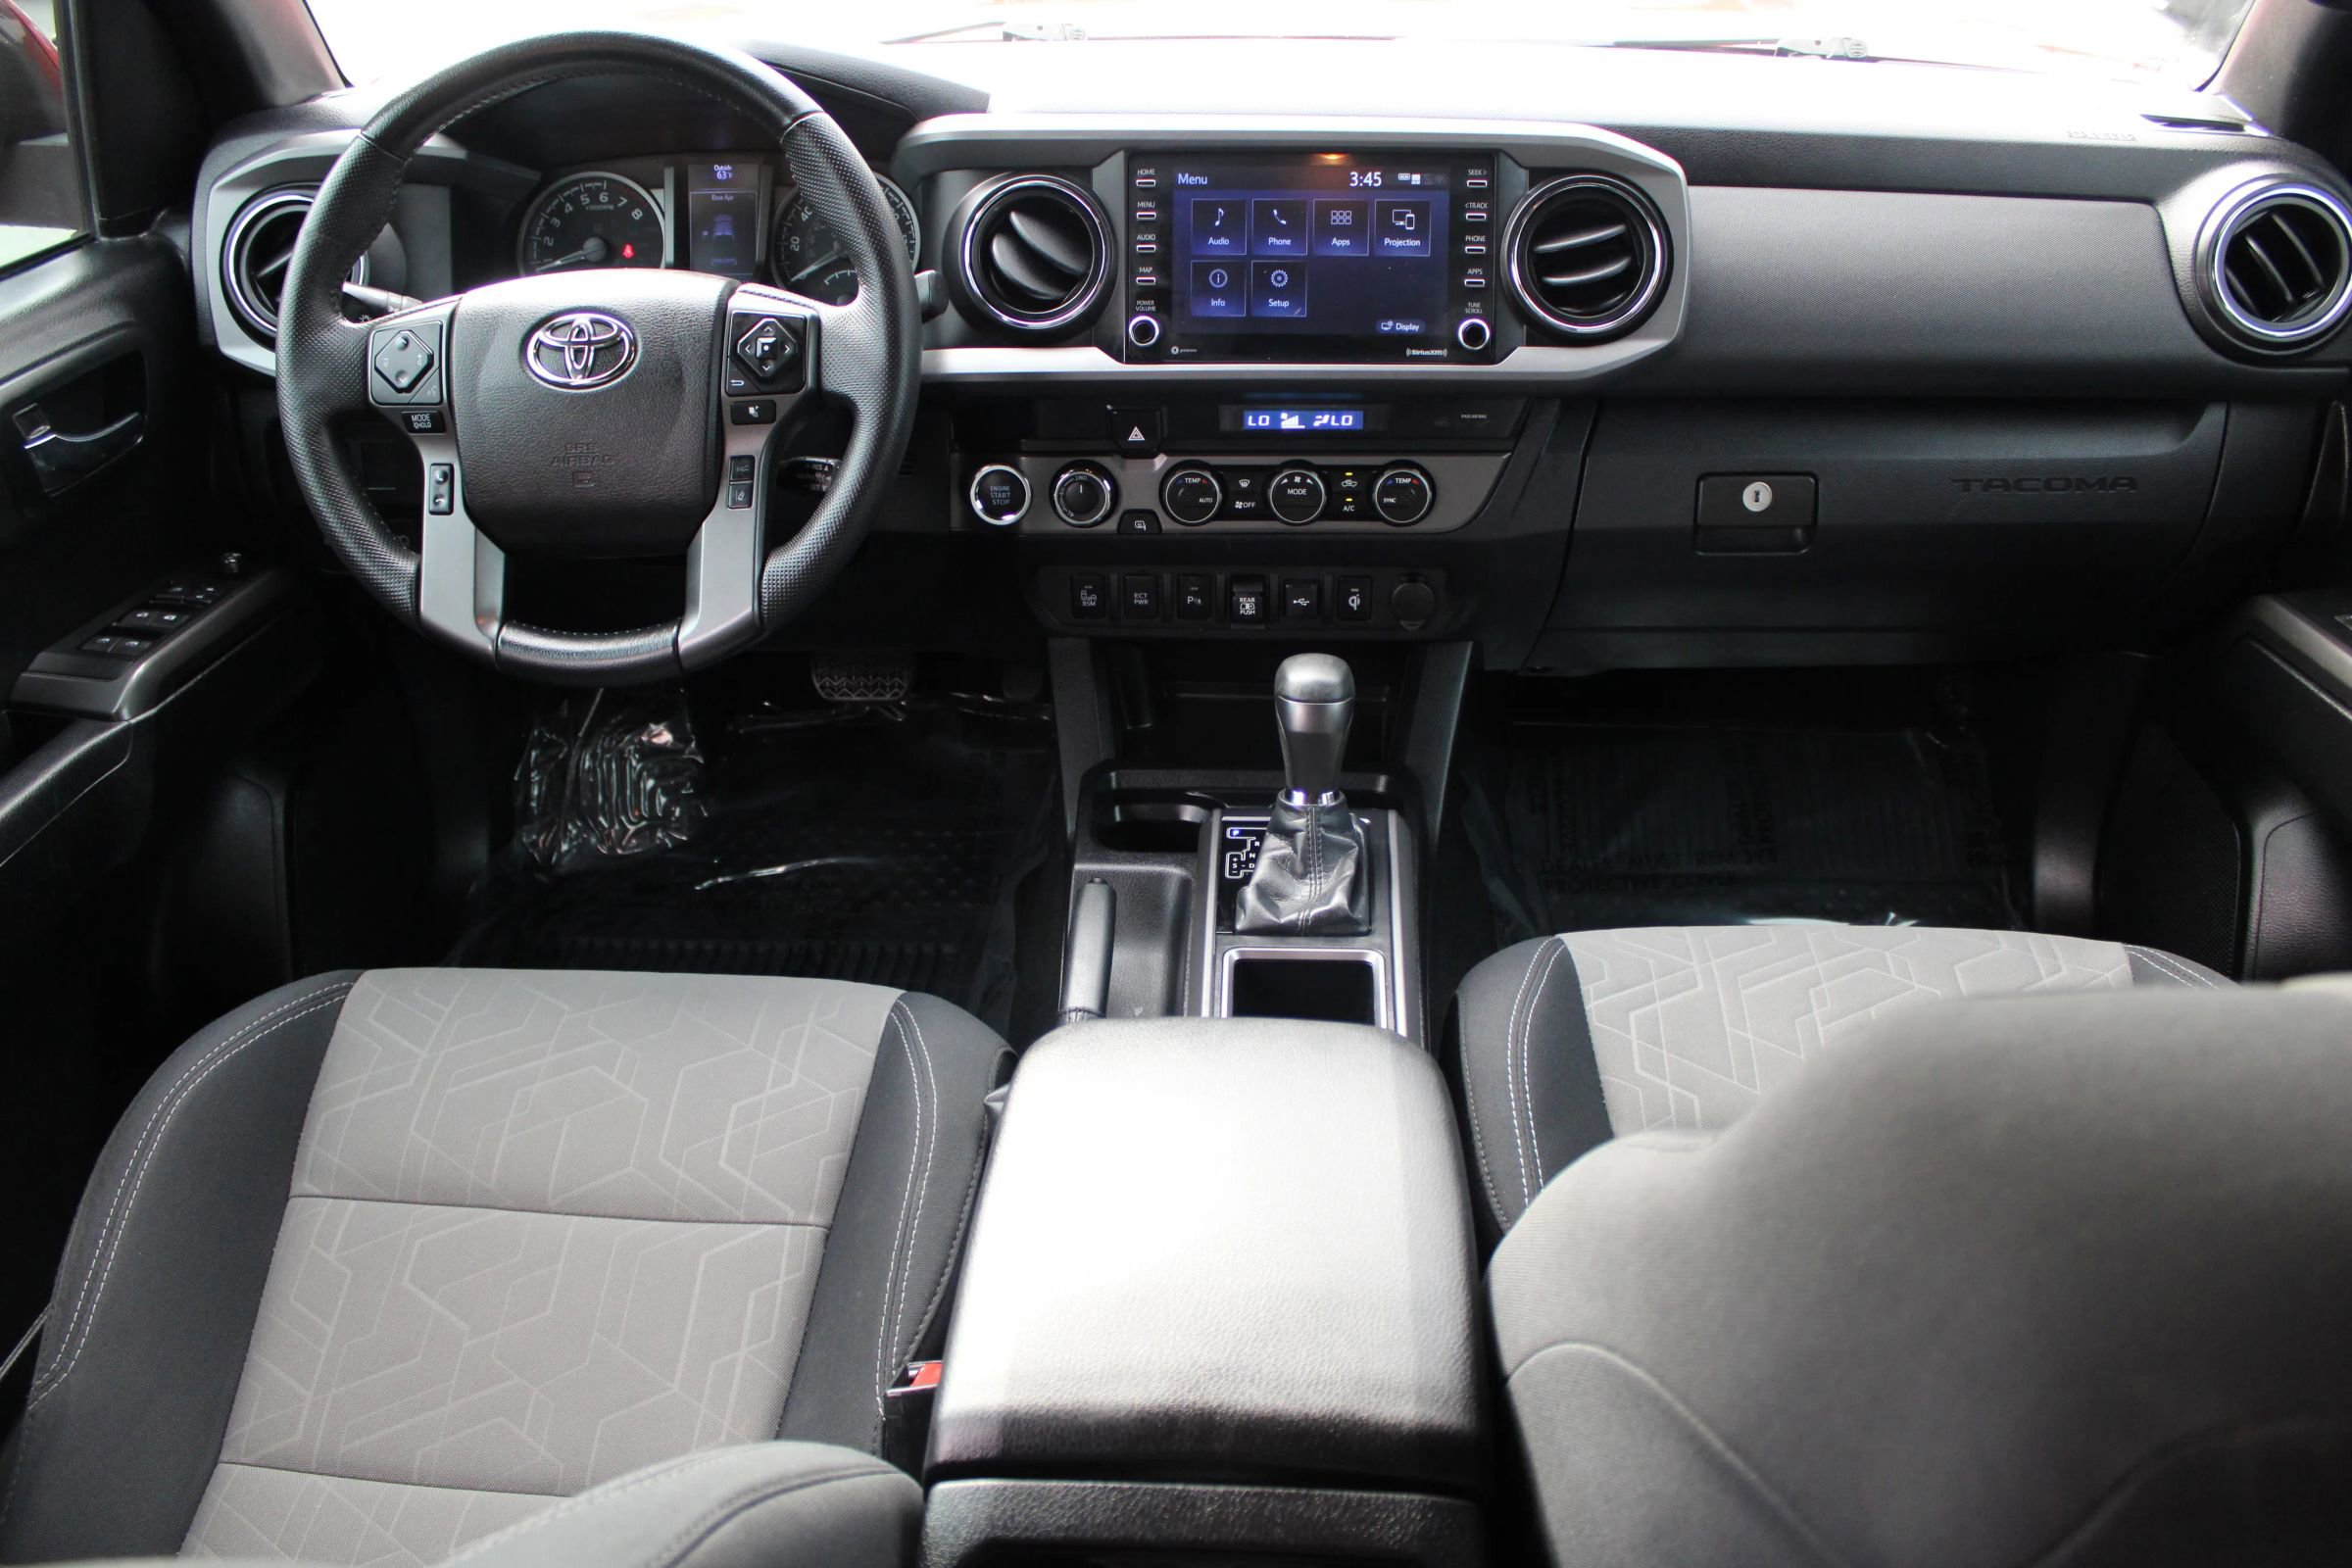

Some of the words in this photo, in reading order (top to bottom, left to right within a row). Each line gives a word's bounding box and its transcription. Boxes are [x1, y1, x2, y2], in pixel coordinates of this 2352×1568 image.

[1178, 172, 1208, 185] Menu
[1349, 171, 1382, 187] 3:45
[580, 193, 590, 205] 5
[599, 192, 609, 203] 6
[617, 196, 628, 208] 7
[564, 202, 573, 214] 4
[631, 208, 644, 220] 8
[550, 217, 562, 228] 3
[543, 235, 555, 247] 2
[790, 235, 801, 252] 20
[1207, 237, 1230, 246] Audio
[1268, 237, 1292, 246] Phone
[1331, 237, 1350, 248] Apps
[1384, 237, 1421, 249] Projection
[1210, 298, 1226, 307] Info
[1268, 298, 1290, 309] Setup
[1396, 322, 1420, 332] Display
[1248, 415, 1270, 426] LO
[1330, 415, 1353, 426] LO
[1951, 476, 2139, 494] TACOMA
